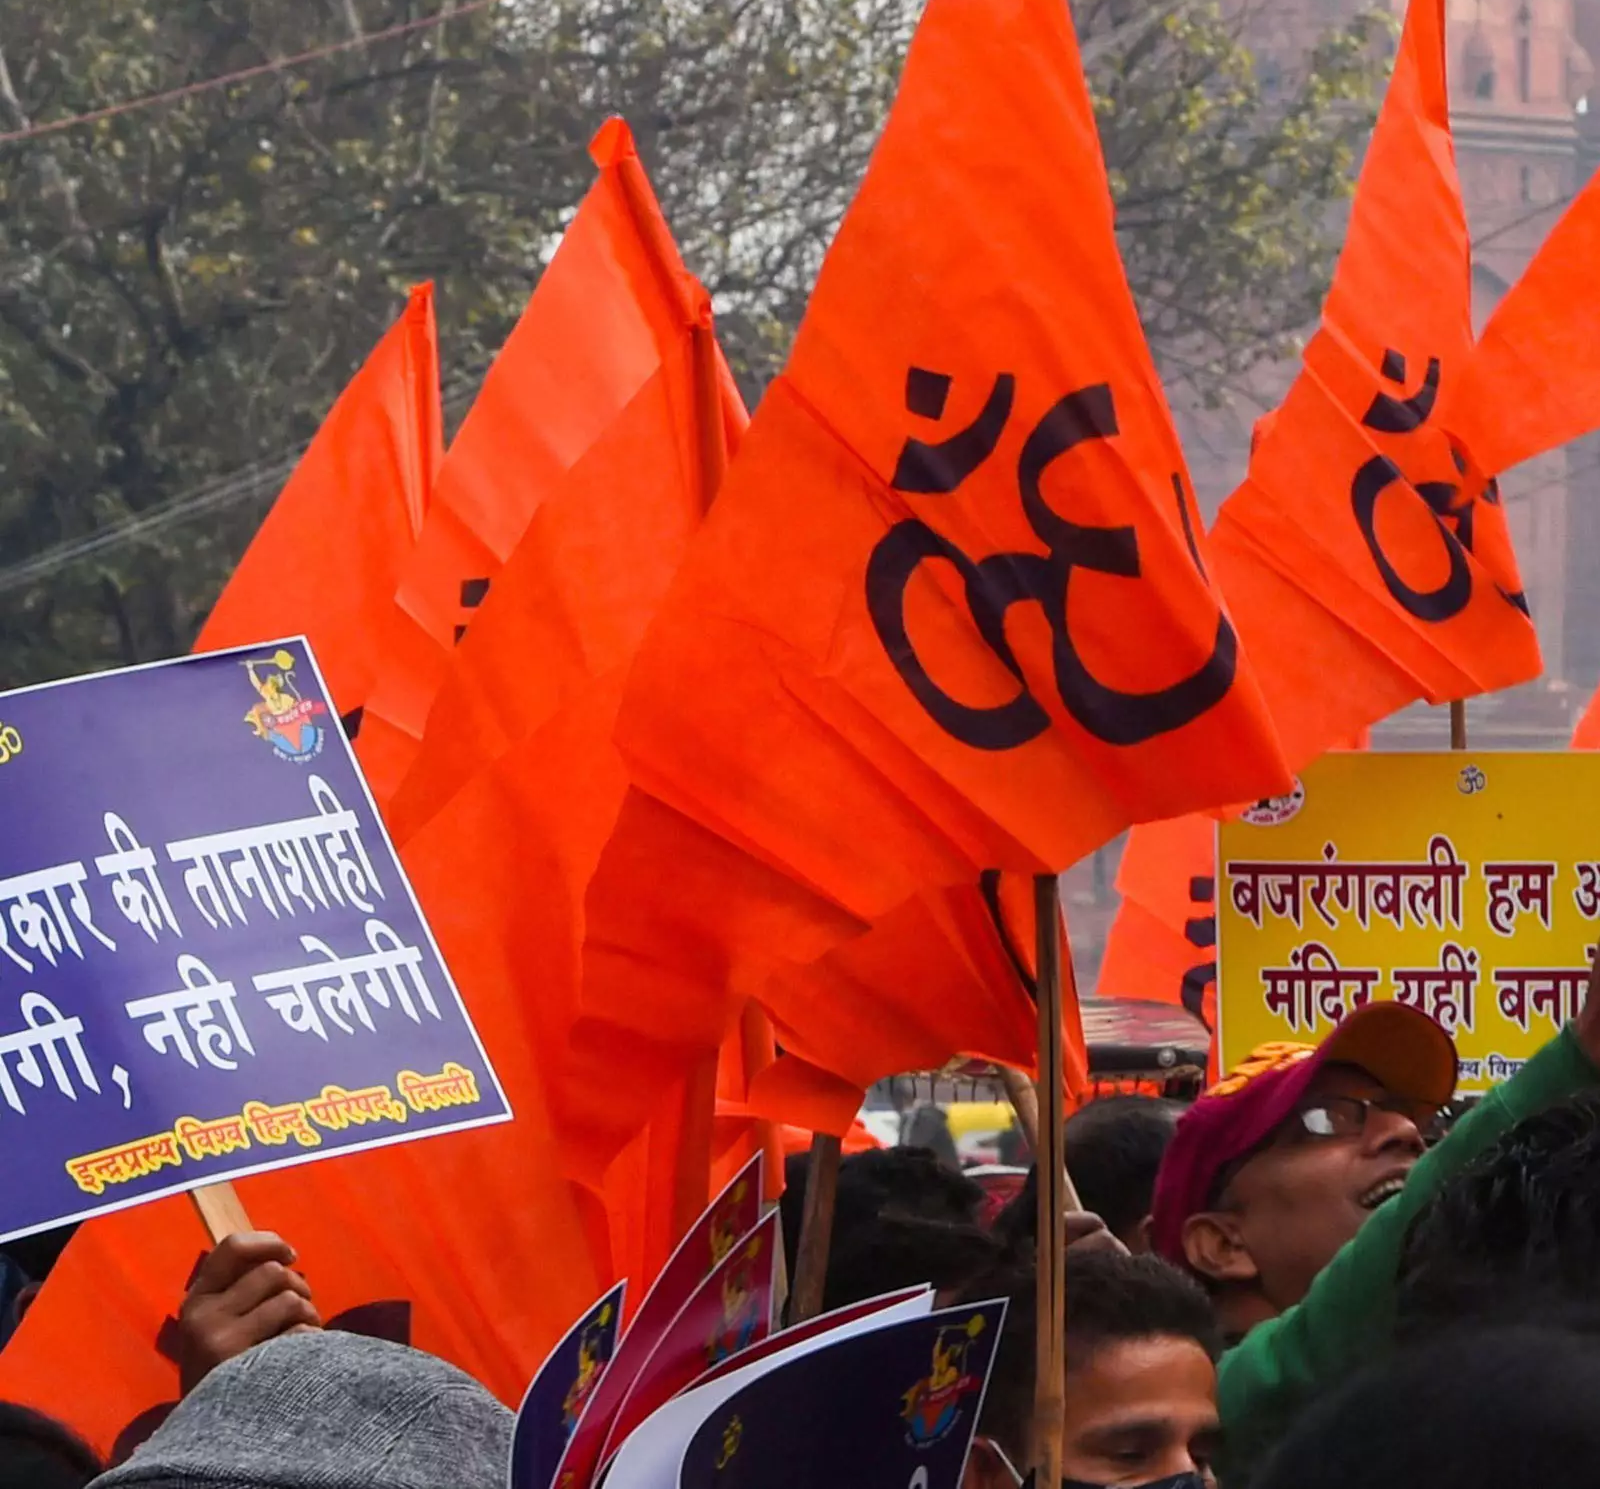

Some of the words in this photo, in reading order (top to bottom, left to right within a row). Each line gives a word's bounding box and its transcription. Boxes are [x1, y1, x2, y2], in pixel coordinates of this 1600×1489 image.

[95, 812, 182, 944] की
[167, 775, 386, 929] तानाशाही
[1228, 834, 1468, 931] बजरंगबली
[1484, 863, 1557, 935] हम
[127, 954, 255, 1070] नही
[254, 919, 441, 1043] चलेगी
[1493, 944, 1597, 1031] बना
[67, 1133, 182, 1194] इन्द्रप्रस्थ
[176, 1116, 249, 1162] विश्व
[243, 1101, 321, 1146] हिन्दू
[397, 1062, 480, 1112] दिल्ली
